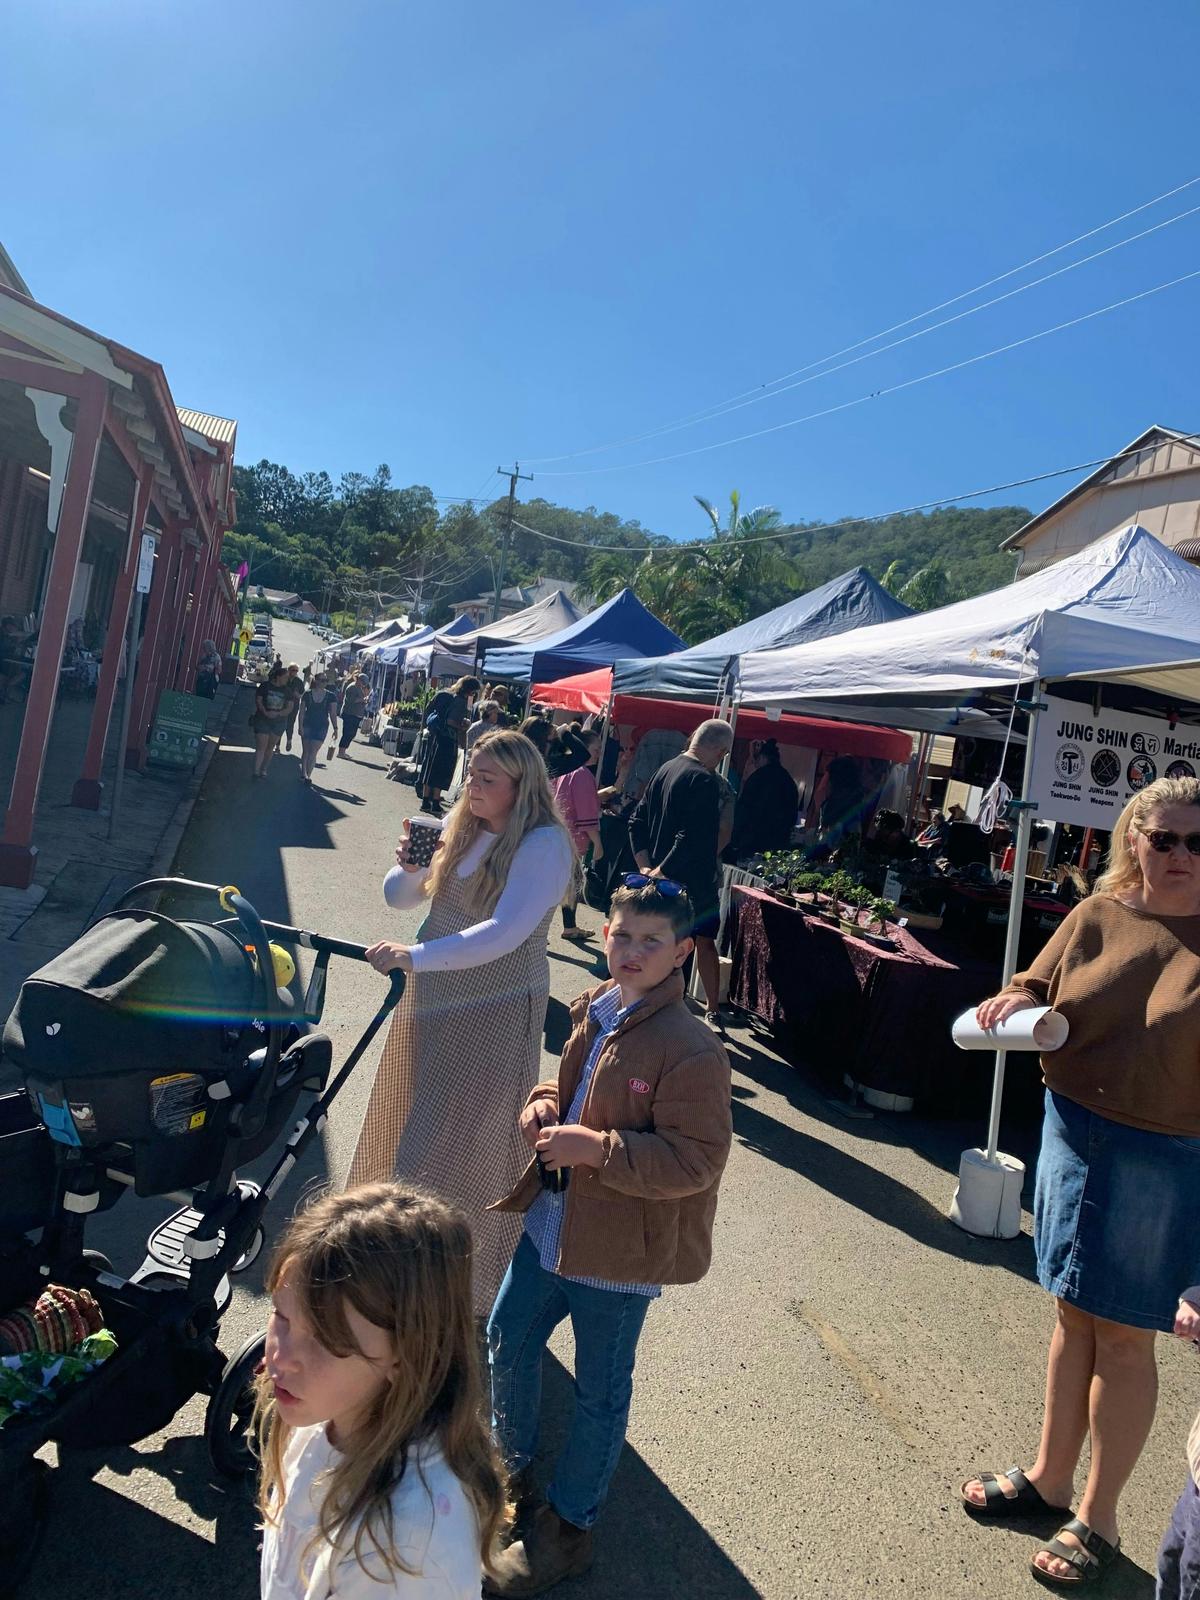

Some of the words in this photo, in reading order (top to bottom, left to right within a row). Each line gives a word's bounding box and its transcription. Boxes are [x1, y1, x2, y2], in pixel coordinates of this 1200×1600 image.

[1057, 721, 1093, 742] JUNG
[1097, 728, 1128, 748] SHIN
[1052, 781, 1067, 789] JUNG
[1069, 783, 1081, 791] SHIN
[1088, 787, 1104, 795] JUNG
[1105, 789, 1119, 797] SHIN
[1090, 797, 1114, 807] Weapons
